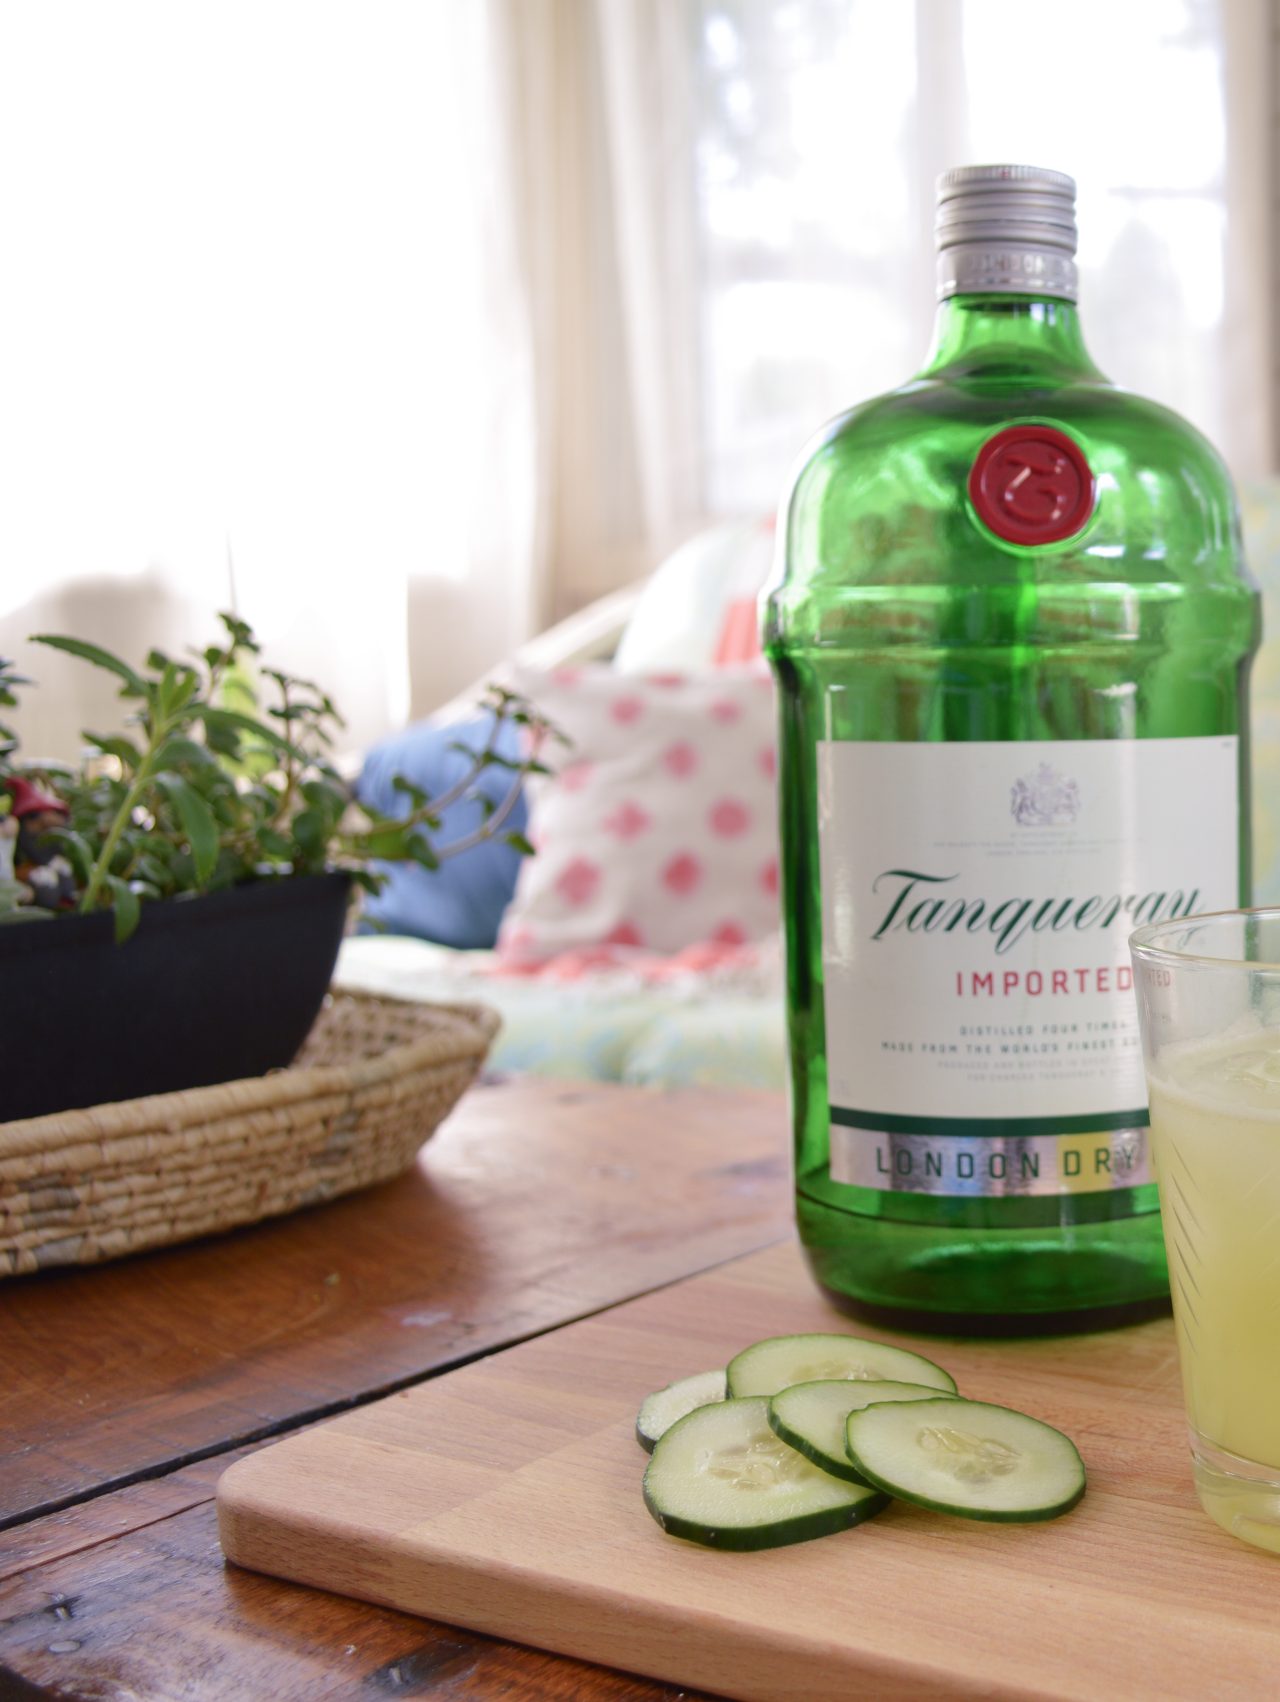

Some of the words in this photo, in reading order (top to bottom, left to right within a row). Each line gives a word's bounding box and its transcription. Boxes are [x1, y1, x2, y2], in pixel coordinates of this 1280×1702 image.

[869, 868, 1207, 957] Tanqueray
[955, 966, 1132, 997] IMPORTED
[959, 1024, 1034, 1037] DISTILLED
[1042, 1022, 1078, 1036] FOUR
[880, 1040, 914, 1053] MADE
[921, 1042, 958, 1054] FROM
[966, 1043, 992, 1055] THE
[876, 1146, 1040, 1179] LONDON
[1063, 1144, 1138, 1176] DRY
